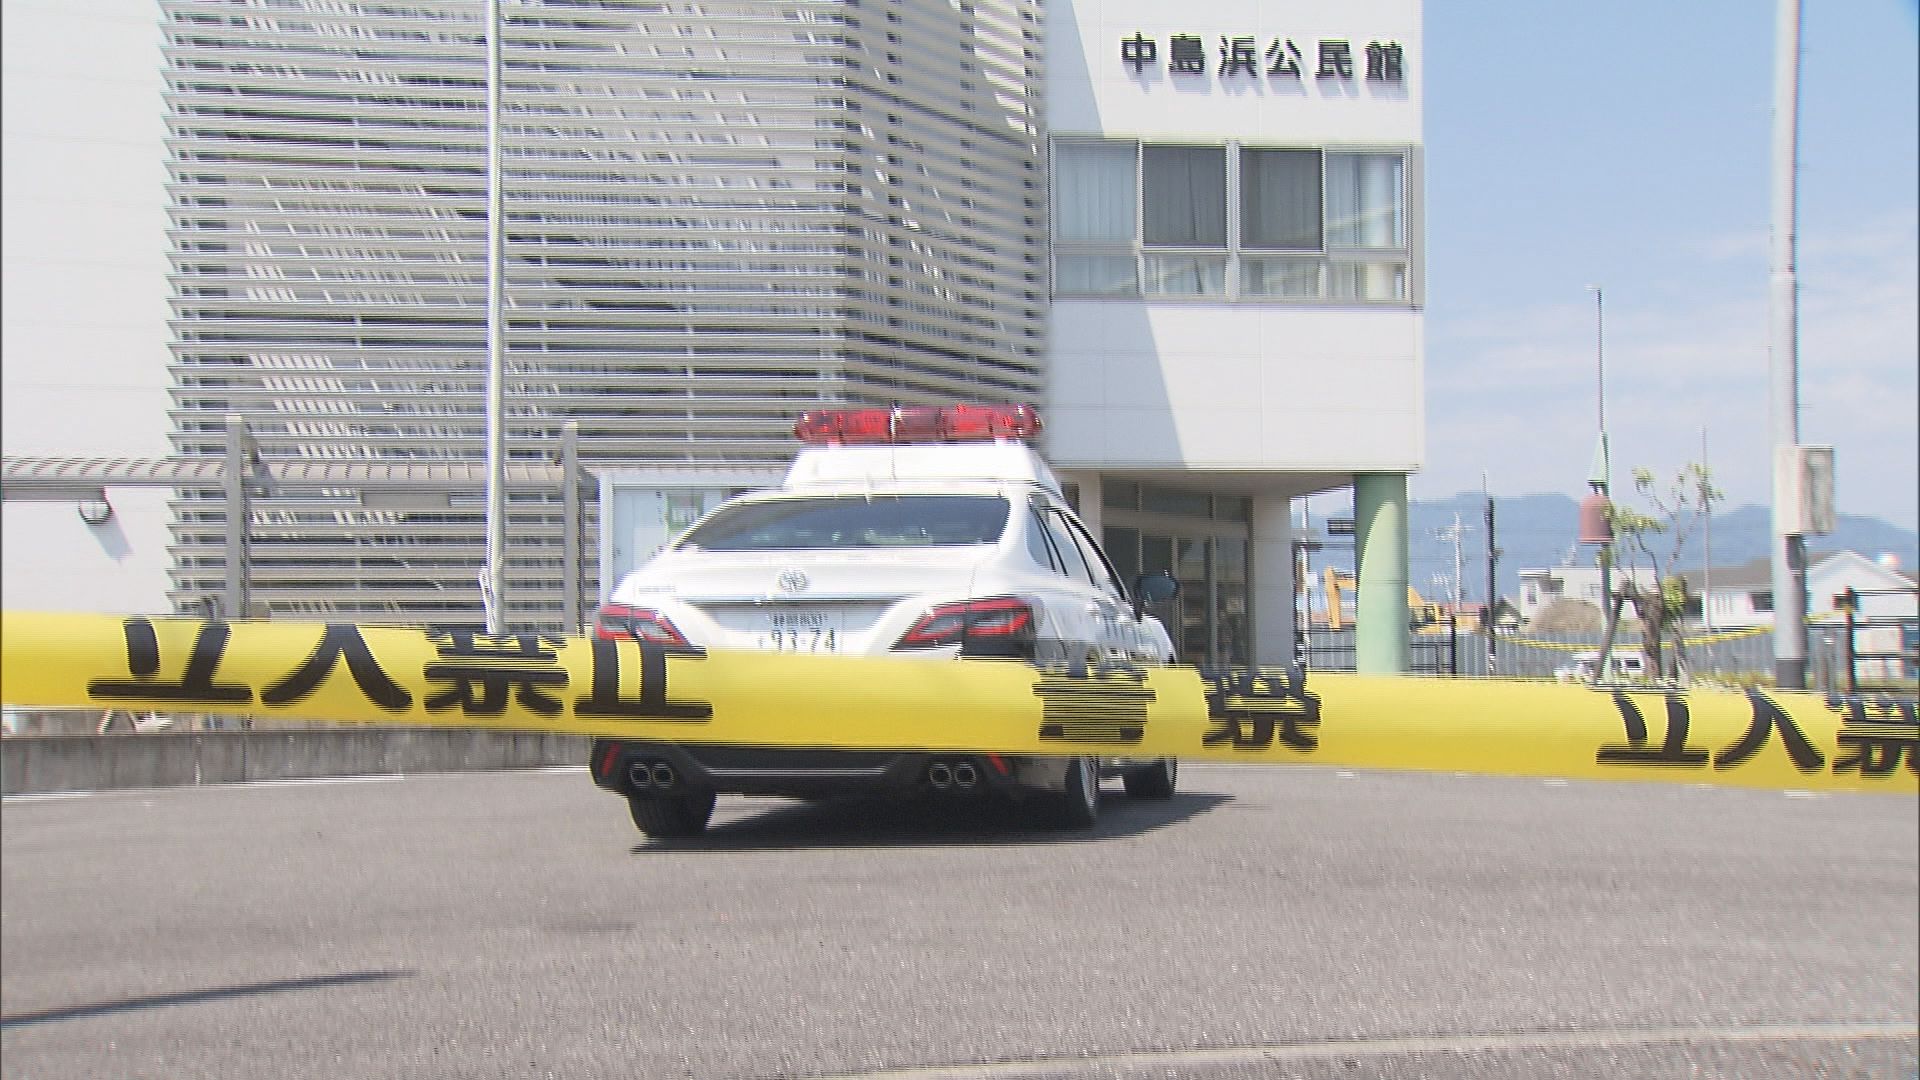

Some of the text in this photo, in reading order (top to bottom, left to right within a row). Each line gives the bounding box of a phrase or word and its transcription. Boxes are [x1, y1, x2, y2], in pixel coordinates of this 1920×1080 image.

[1121, 32, 1403, 80] 中島浜公民館
